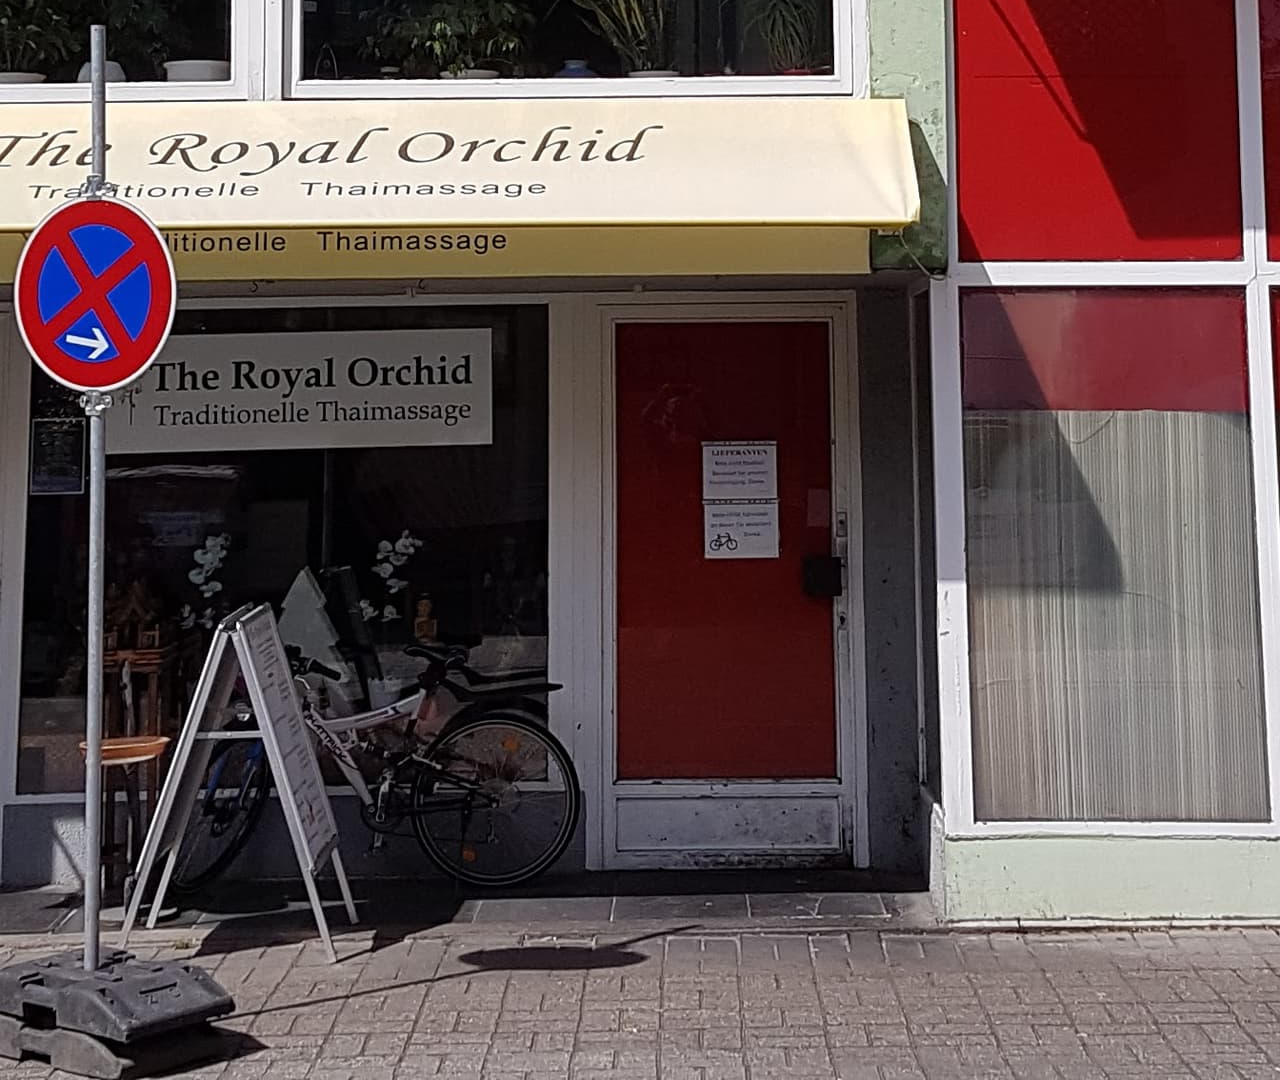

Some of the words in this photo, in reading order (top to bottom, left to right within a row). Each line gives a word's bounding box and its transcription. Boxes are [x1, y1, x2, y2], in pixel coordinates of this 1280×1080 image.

[148, 125, 389, 178] Royal
[397, 124, 664, 164] Orchid
[28, 182, 260, 199] Traitionelle
[300, 181, 548, 198] Thaimassage
[317, 230, 507, 255] Thaimassage
[151, 360, 220, 392] The
[231, 357, 336, 398] Royal
[348, 355, 473, 387] Orchid
[154, 401, 309, 426] Traditionelle
[316, 400, 472, 426] Thaimassage
